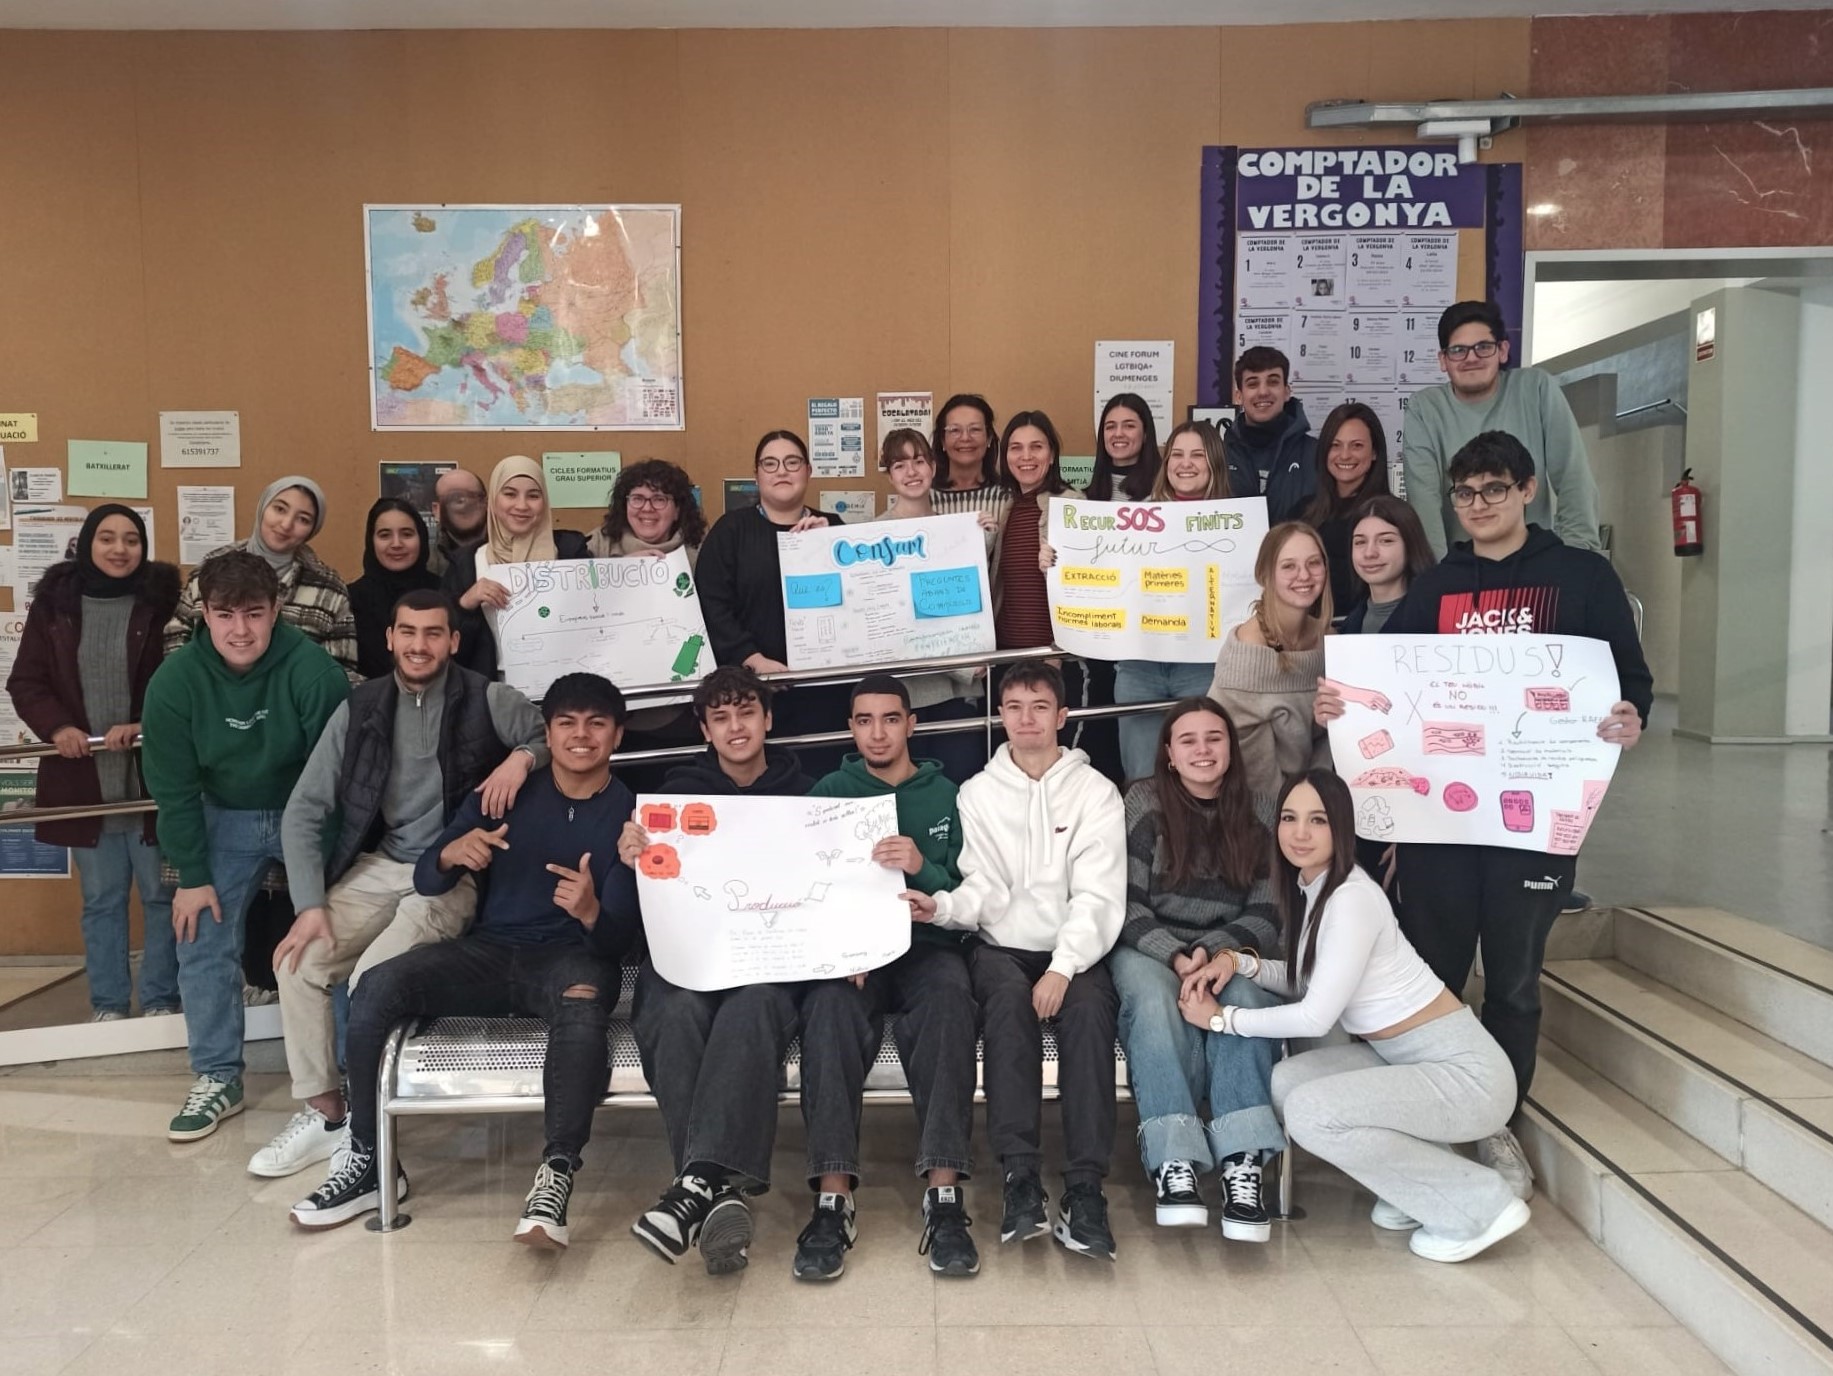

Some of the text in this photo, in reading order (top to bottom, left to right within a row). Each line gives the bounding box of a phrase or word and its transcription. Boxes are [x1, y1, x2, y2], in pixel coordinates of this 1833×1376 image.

[1238, 150, 1458, 177] COMPTADOR
[1297, 175, 1414, 201] DE LA
[1248, 202, 1453, 229] VERGONYA
[1245, 258, 1250, 272] 1
[1297, 254, 1304, 269] 2
[1351, 252, 1359, 267] 3
[1405, 256, 1412, 270] 4
[1301, 315, 1308, 328] 7
[1353, 317, 1360, 331] 9
[1405, 317, 1415, 331] 11
[1239, 333, 1246, 347] 5
[1130, 350, 1160, 358] FORUM
[1300, 344, 1307, 357] 8
[1350, 346, 1361, 359] 10
[1404, 350, 1415, 363] 12
[1115, 363, 1153, 371] LGTBIQA+
[86, 462, 131, 471] BATXILLERAT
[550, 466, 617, 475] CICLES FORMATIUS
[577, 474, 612, 482] SUPERIOR
[1062, 504, 1244, 533] RECURSOS FINITS
[508, 556, 670, 595] DISTRIBUCIÓ
[1064, 570, 1117, 582] EXTRACCIÓ
[1144, 570, 1183, 580] Matèries
[1145, 579, 1185, 589] primeres
[1058, 615, 1089, 626] normes
[1141, 615, 1187, 626] Demanda
[1449, 690, 1468, 701] NO
[1523, 879, 1554, 891] PUMA
